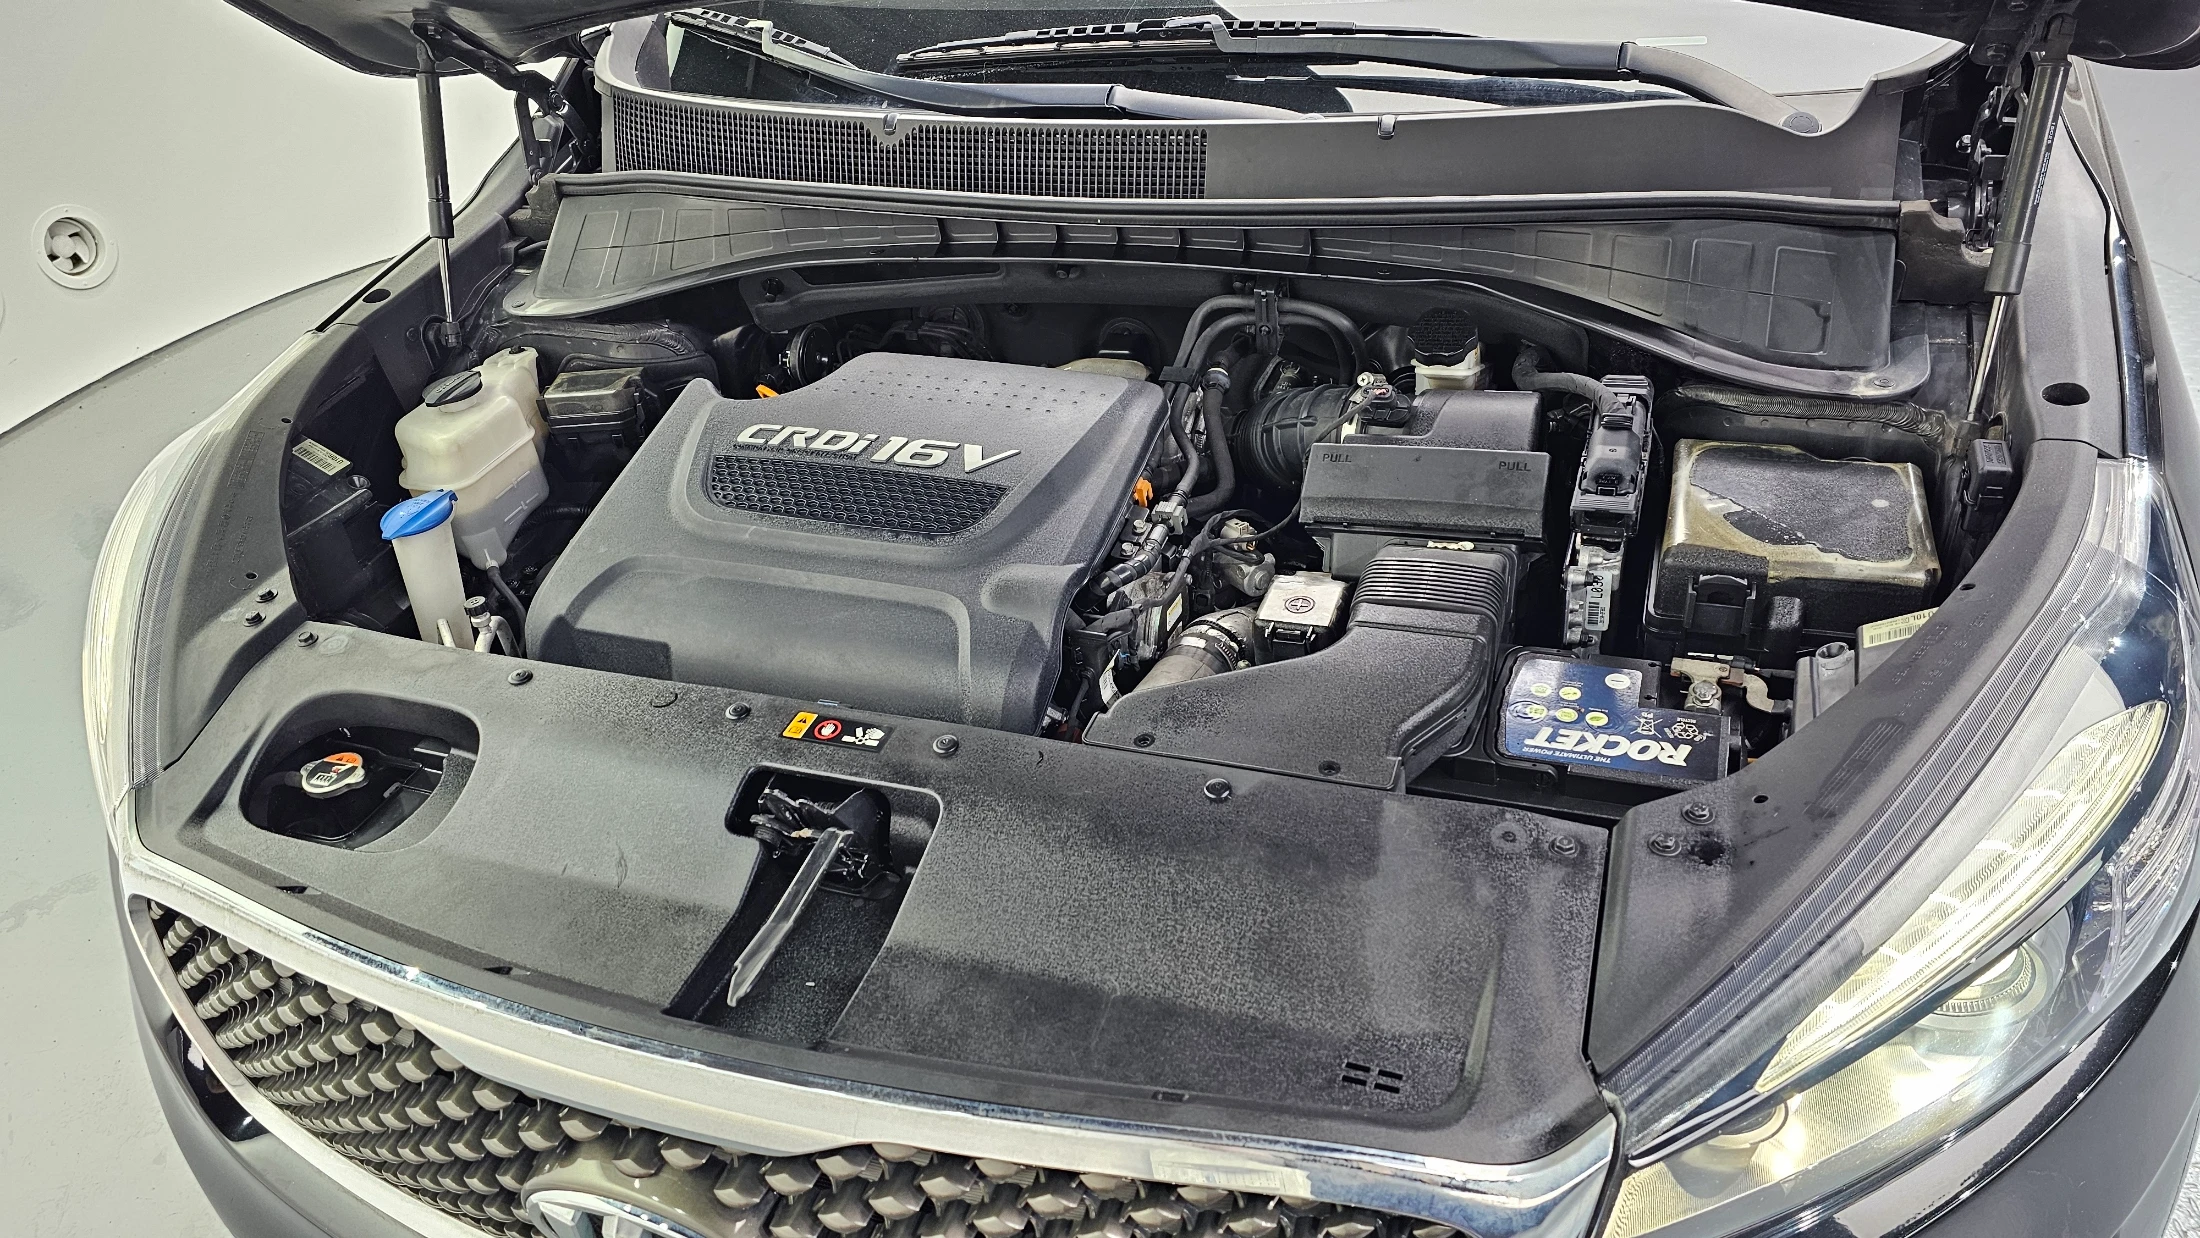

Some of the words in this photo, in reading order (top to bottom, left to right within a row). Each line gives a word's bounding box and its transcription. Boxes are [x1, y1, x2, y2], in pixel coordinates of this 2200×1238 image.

[737, 423, 880, 454] CRDi
[1322, 453, 1352, 463] PULL
[1498, 461, 1532, 472] PULL
[1522, 746, 1553, 756] POWER
[1524, 727, 1693, 767] ROCKET
[1553, 750, 1594, 762] ULTIMATE
[1594, 756, 1612, 764] THE
